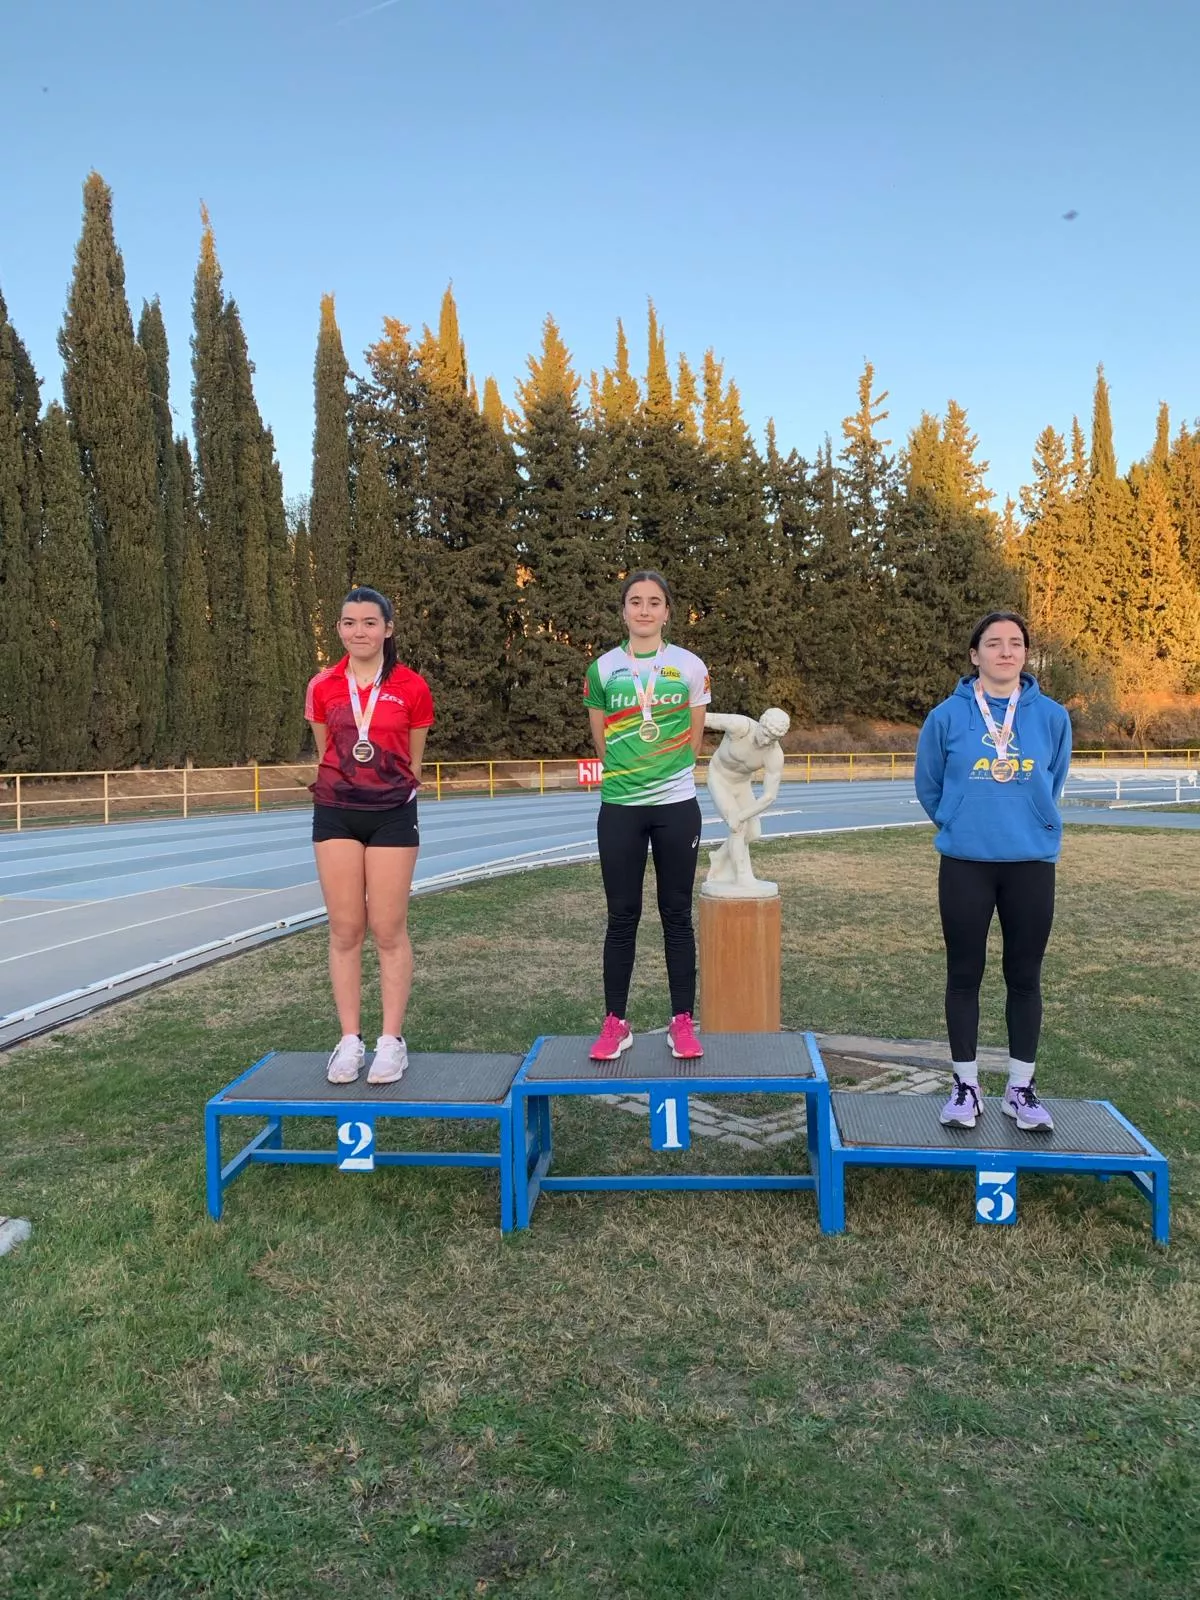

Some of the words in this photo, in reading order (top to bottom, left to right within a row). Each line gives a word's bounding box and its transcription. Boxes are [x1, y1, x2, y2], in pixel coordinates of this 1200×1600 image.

[611, 692, 683, 709] Husca
[338, 1121, 374, 1170] 2
[656, 1098, 682, 1148] 1
[977, 1171, 1015, 1221] 3
